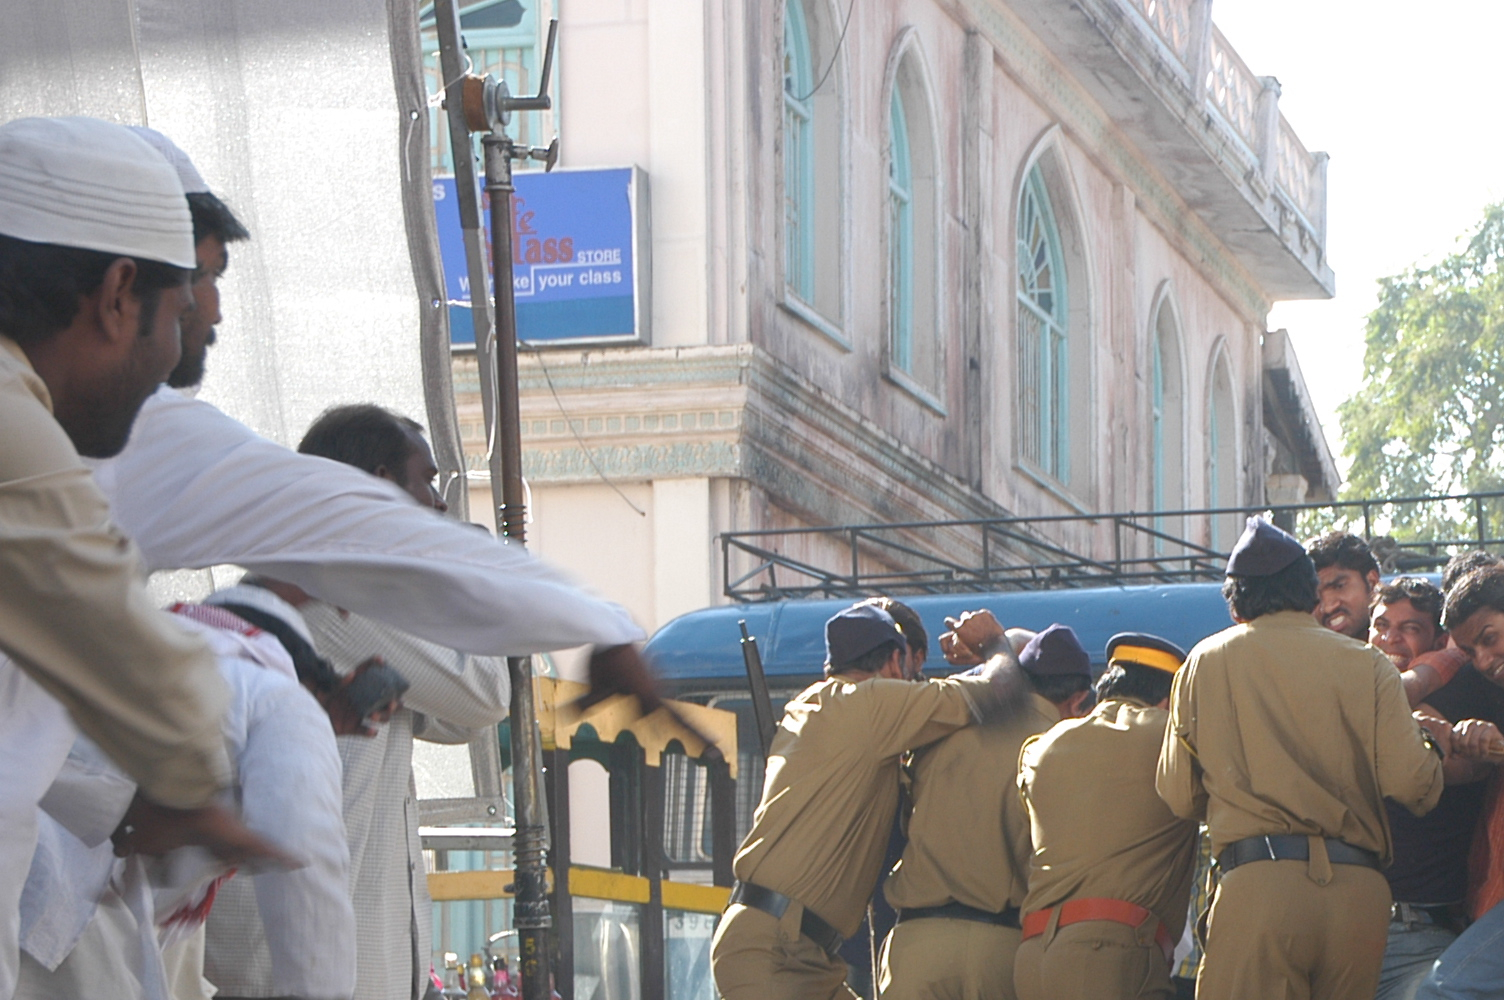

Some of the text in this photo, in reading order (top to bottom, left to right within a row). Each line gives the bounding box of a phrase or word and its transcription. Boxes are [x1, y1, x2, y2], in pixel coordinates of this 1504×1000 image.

[577, 248, 622, 264] STORE
[538, 273, 575, 292] your
[579, 269, 622, 286] class
